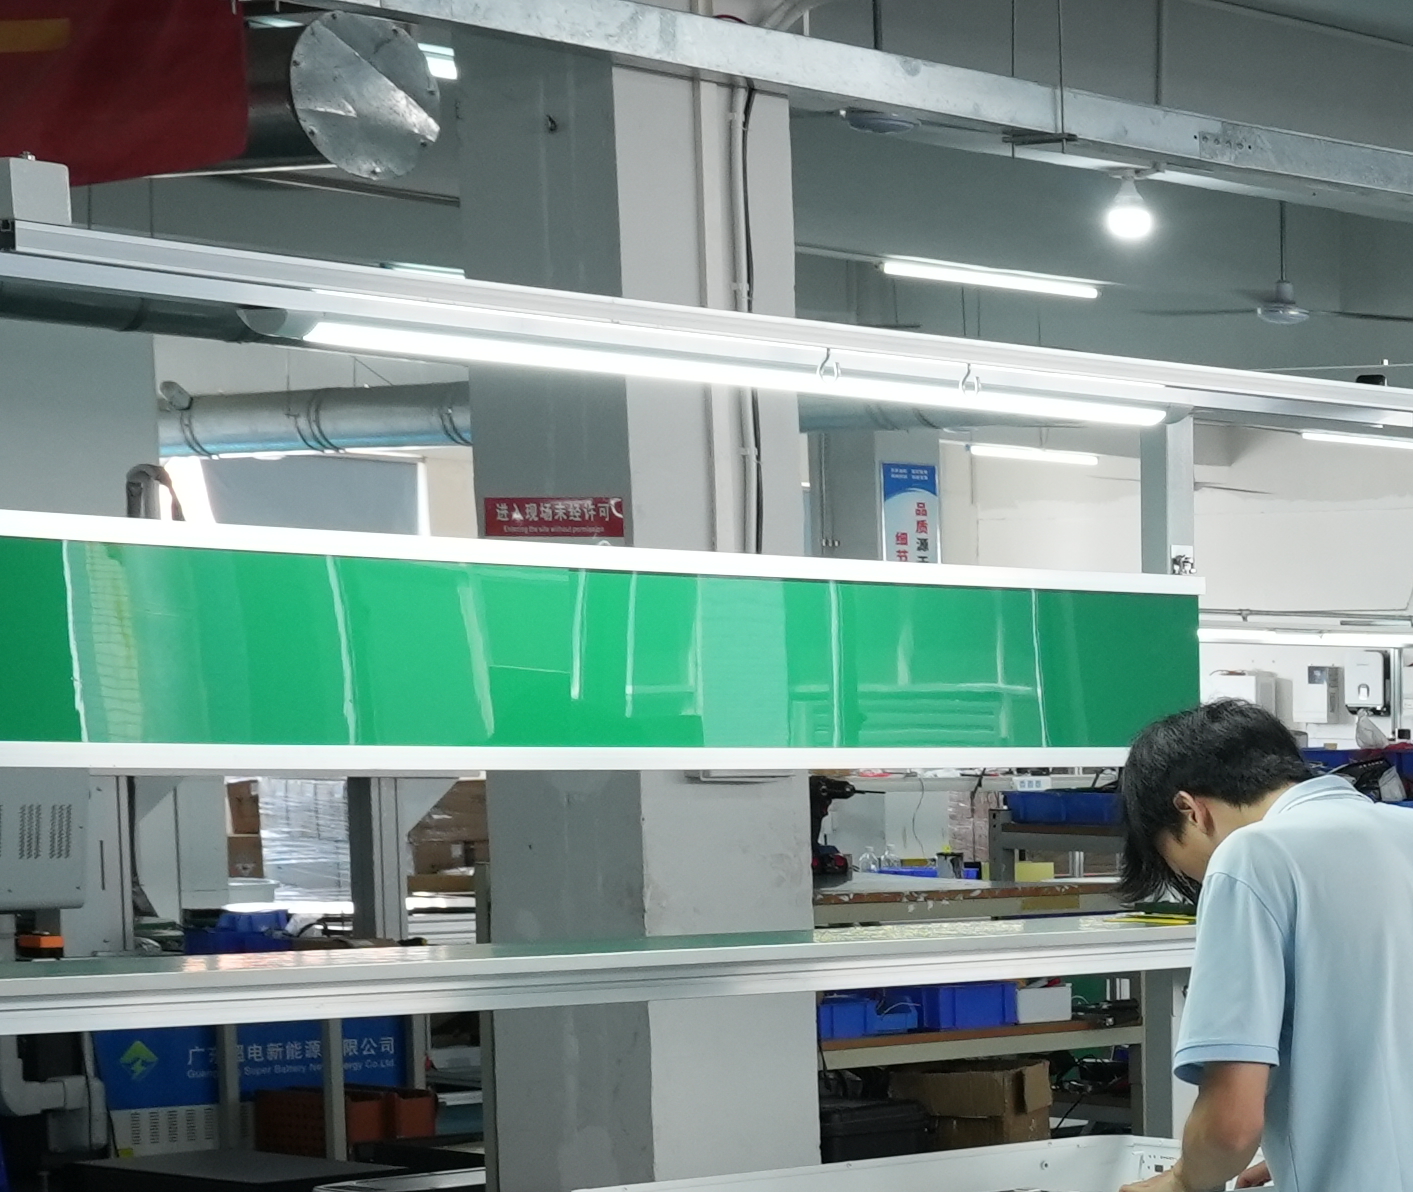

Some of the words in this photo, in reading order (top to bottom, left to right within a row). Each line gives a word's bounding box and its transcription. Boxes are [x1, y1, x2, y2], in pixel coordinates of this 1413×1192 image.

[496, 503, 610, 521] 进入现场未经许可
[187, 1036, 395, 1065] 广超电新能源限公司
